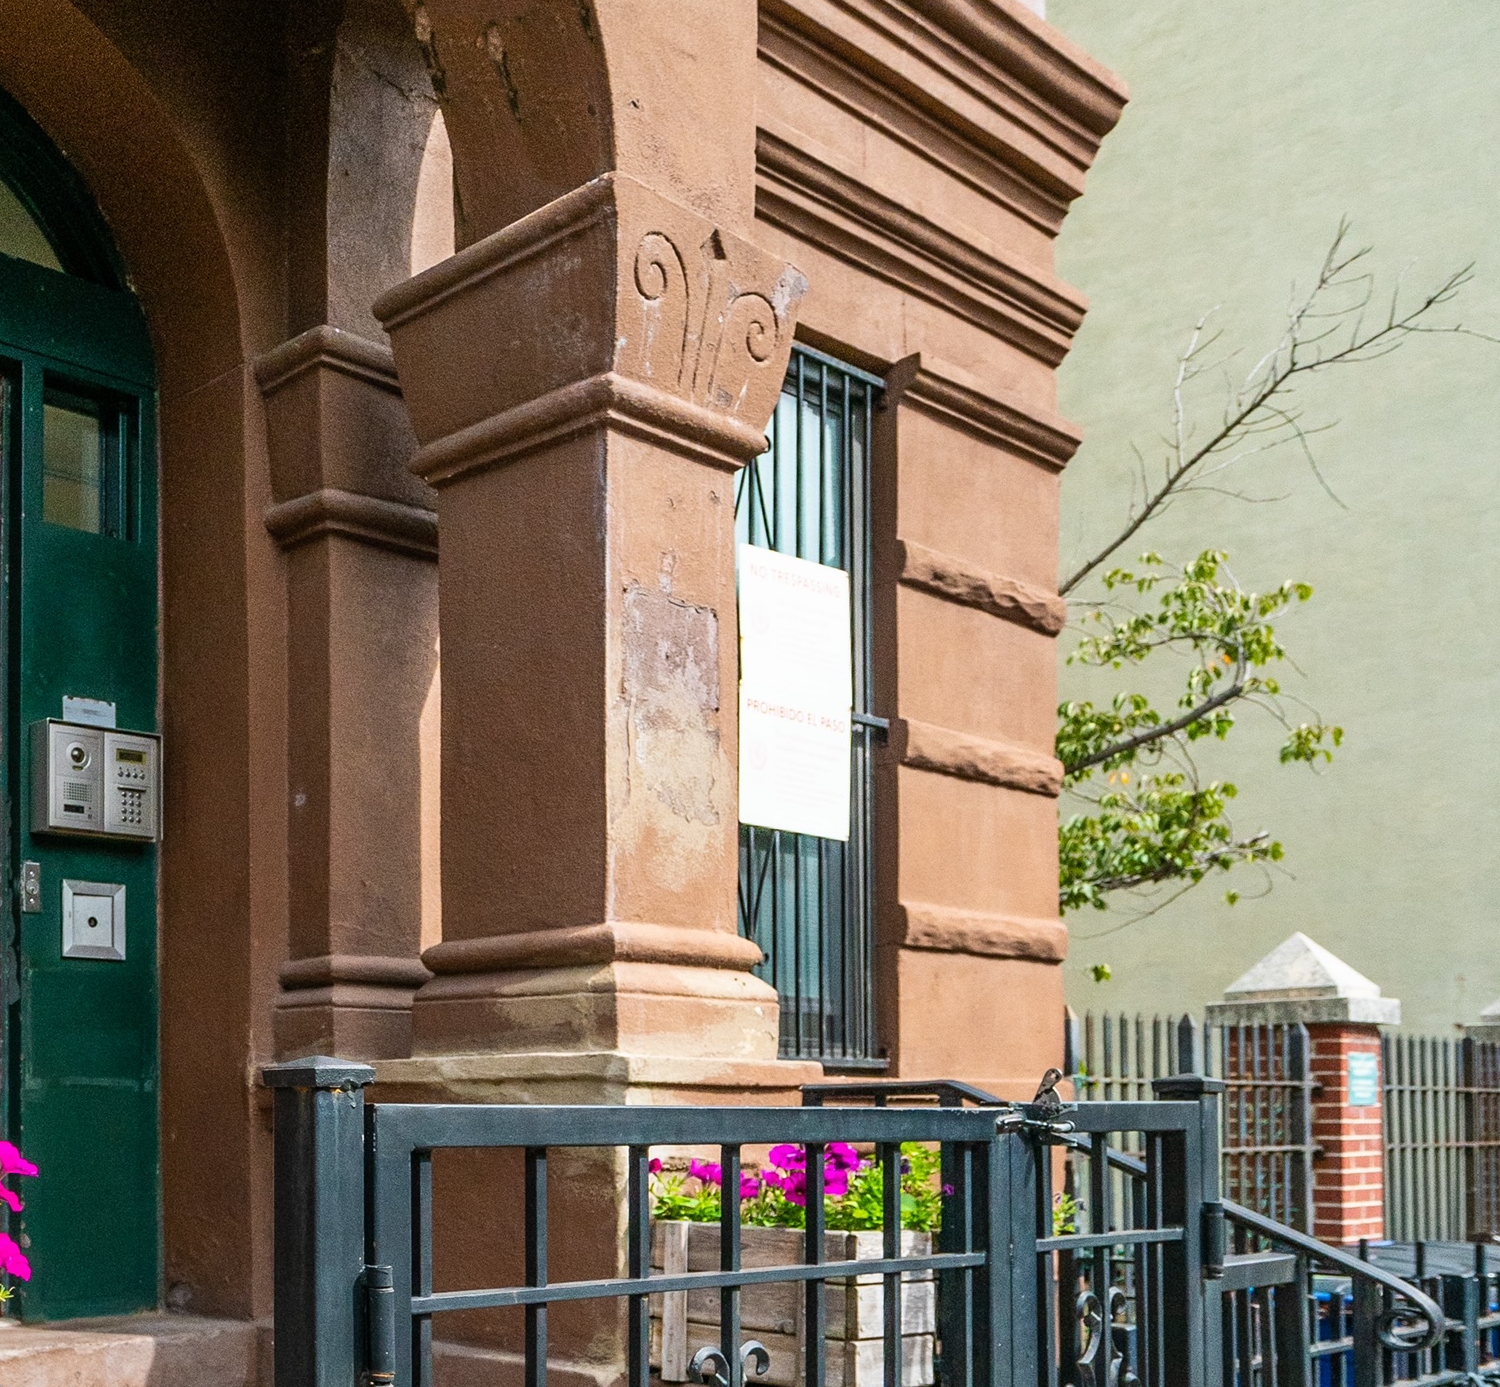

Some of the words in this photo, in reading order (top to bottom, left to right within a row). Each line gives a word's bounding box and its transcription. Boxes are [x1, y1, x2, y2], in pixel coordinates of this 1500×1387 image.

[750, 564, 768, 579] NO
[771, 568, 841, 599] TRESPASSING
[747, 698, 805, 724] PROHIBIDO
[807, 712, 818, 728] EL
[820, 717, 846, 734] PASO
